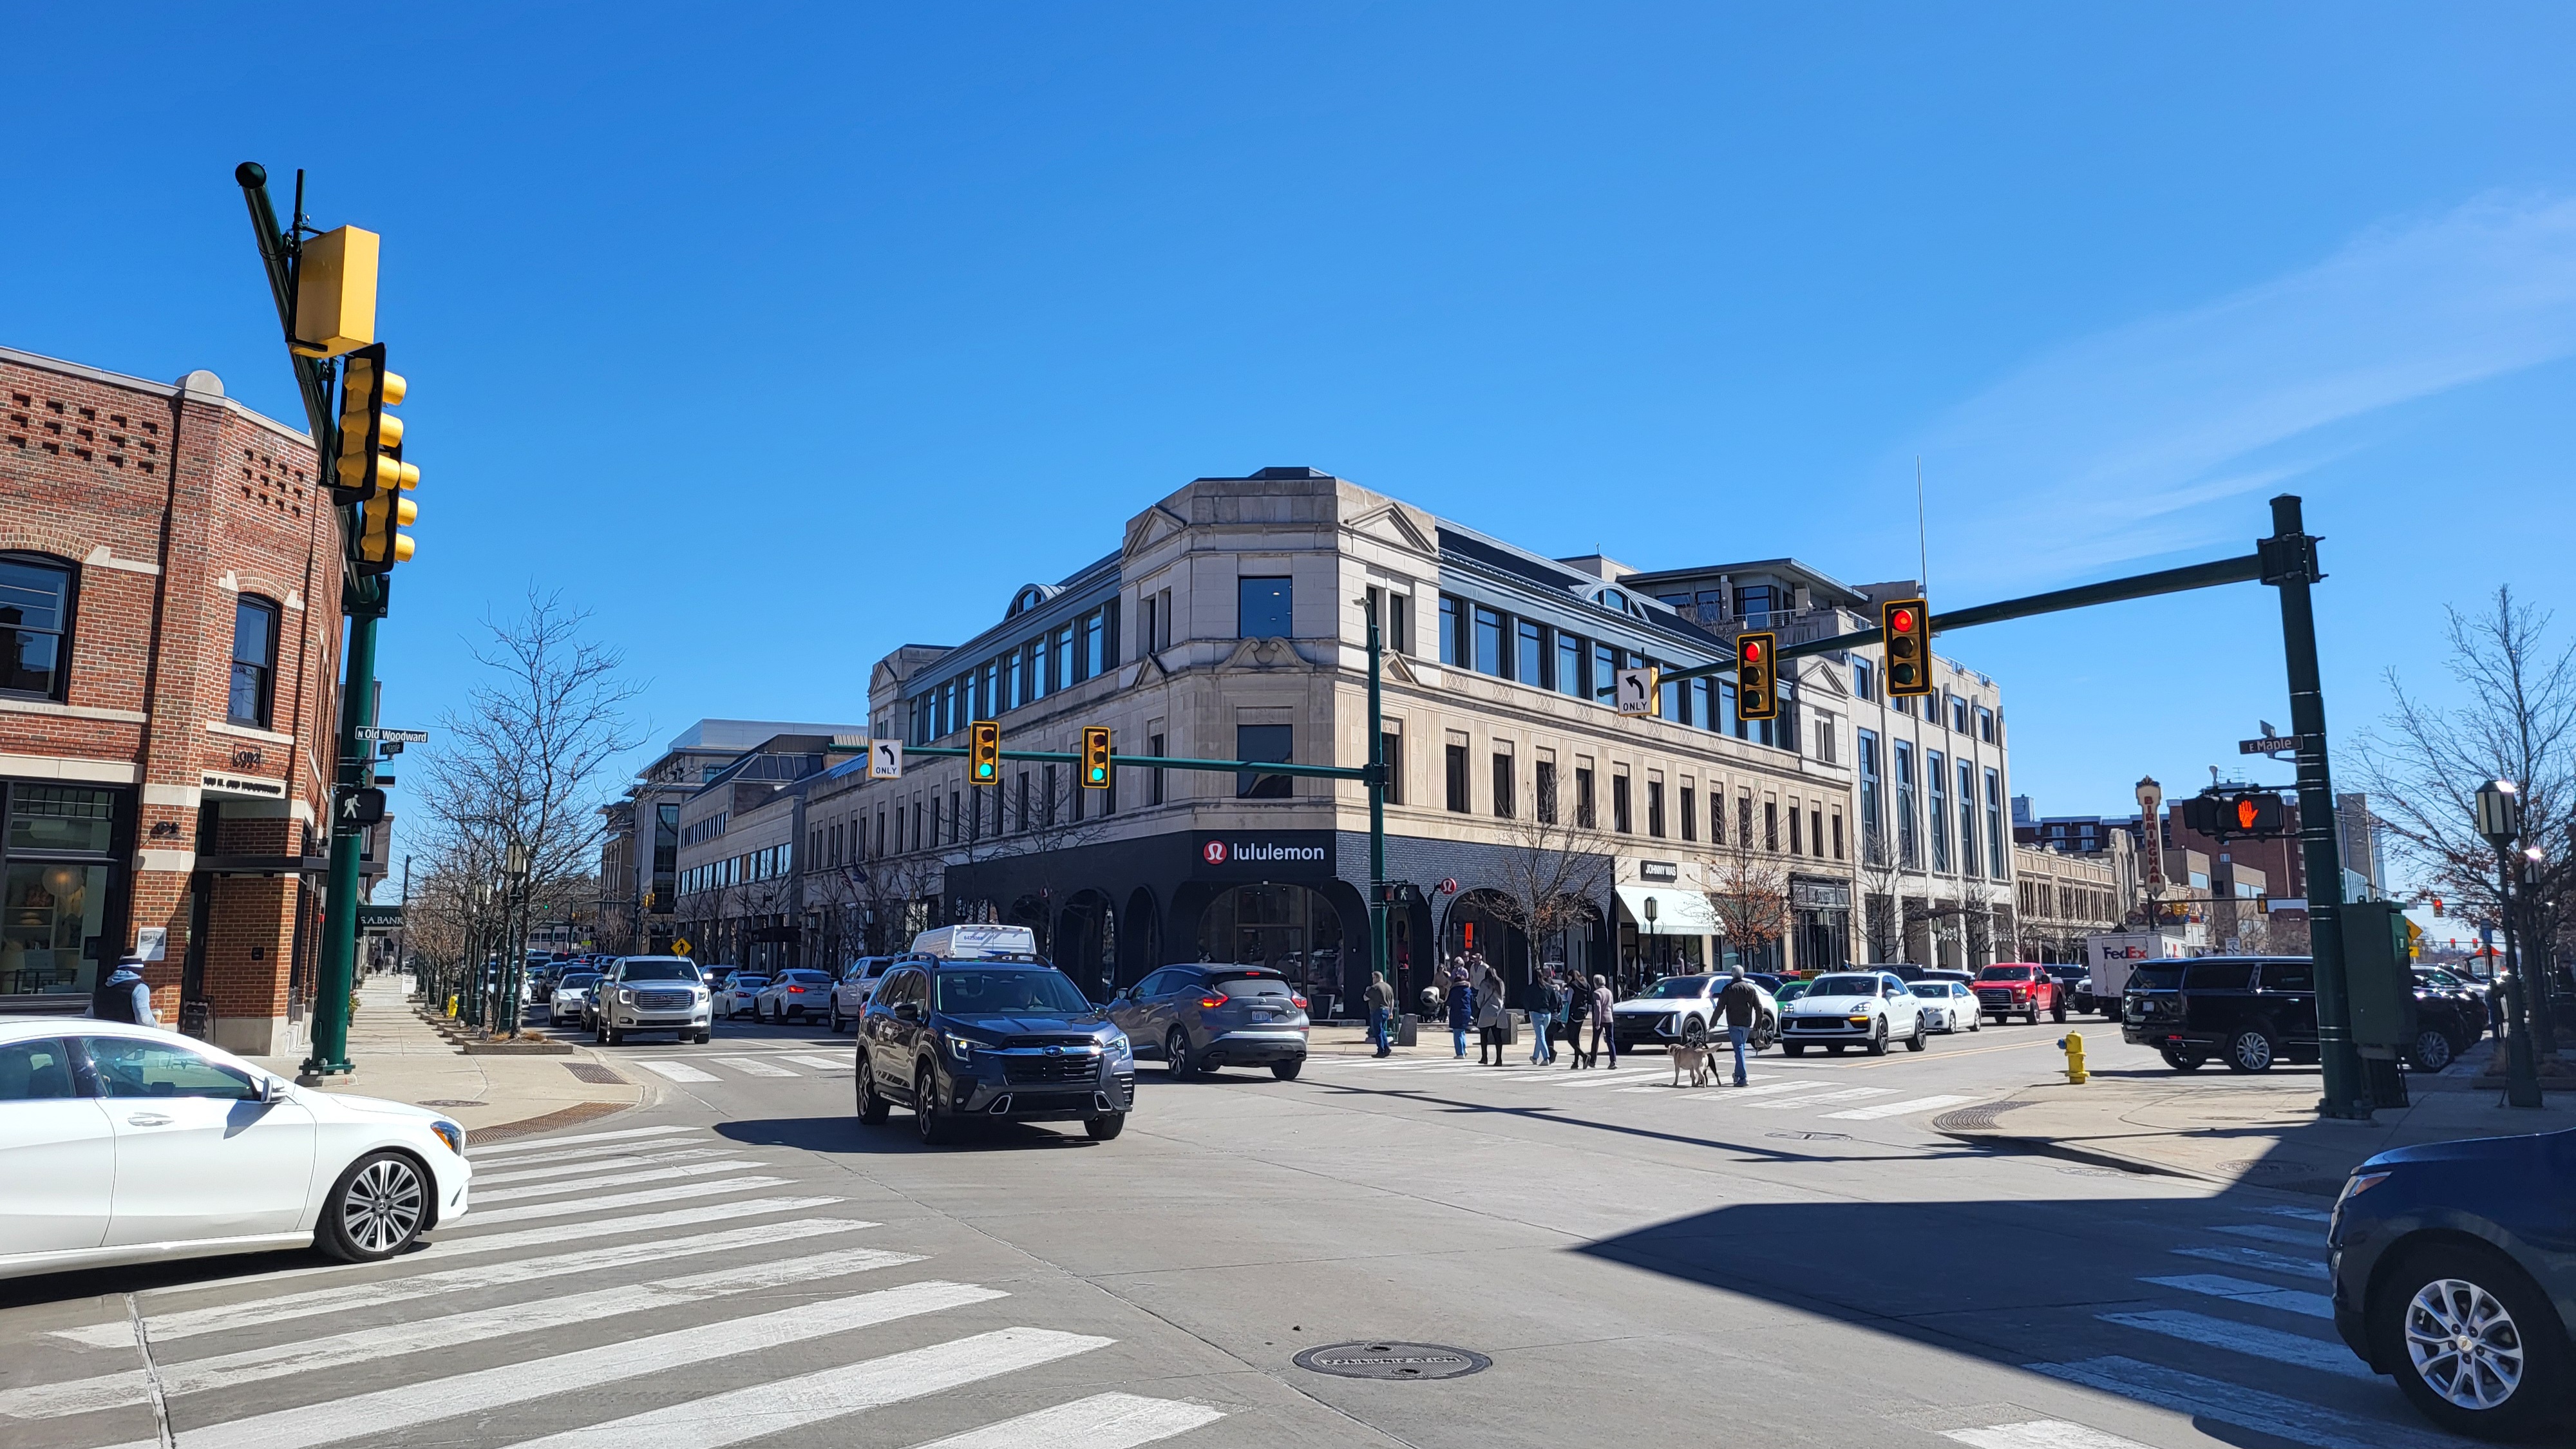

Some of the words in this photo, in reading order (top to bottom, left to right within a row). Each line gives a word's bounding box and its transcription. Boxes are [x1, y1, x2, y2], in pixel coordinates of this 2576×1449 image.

[1623, 701, 1647, 712] ONLY
[365, 728, 379, 739] Old
[382, 730, 427, 742] Woodward
[2249, 743, 2254, 752] E
[2257, 739, 2292, 751] Maple
[876, 766, 897, 775] ONLY
[2144, 796, 2160, 884] BIRMINGHAM
[1234, 843, 1324, 860] lululemon
[1645, 864, 1665, 875] JOHNNY
[1665, 866, 1676, 876] WAS
[2102, 946, 2147, 960] FedEx
